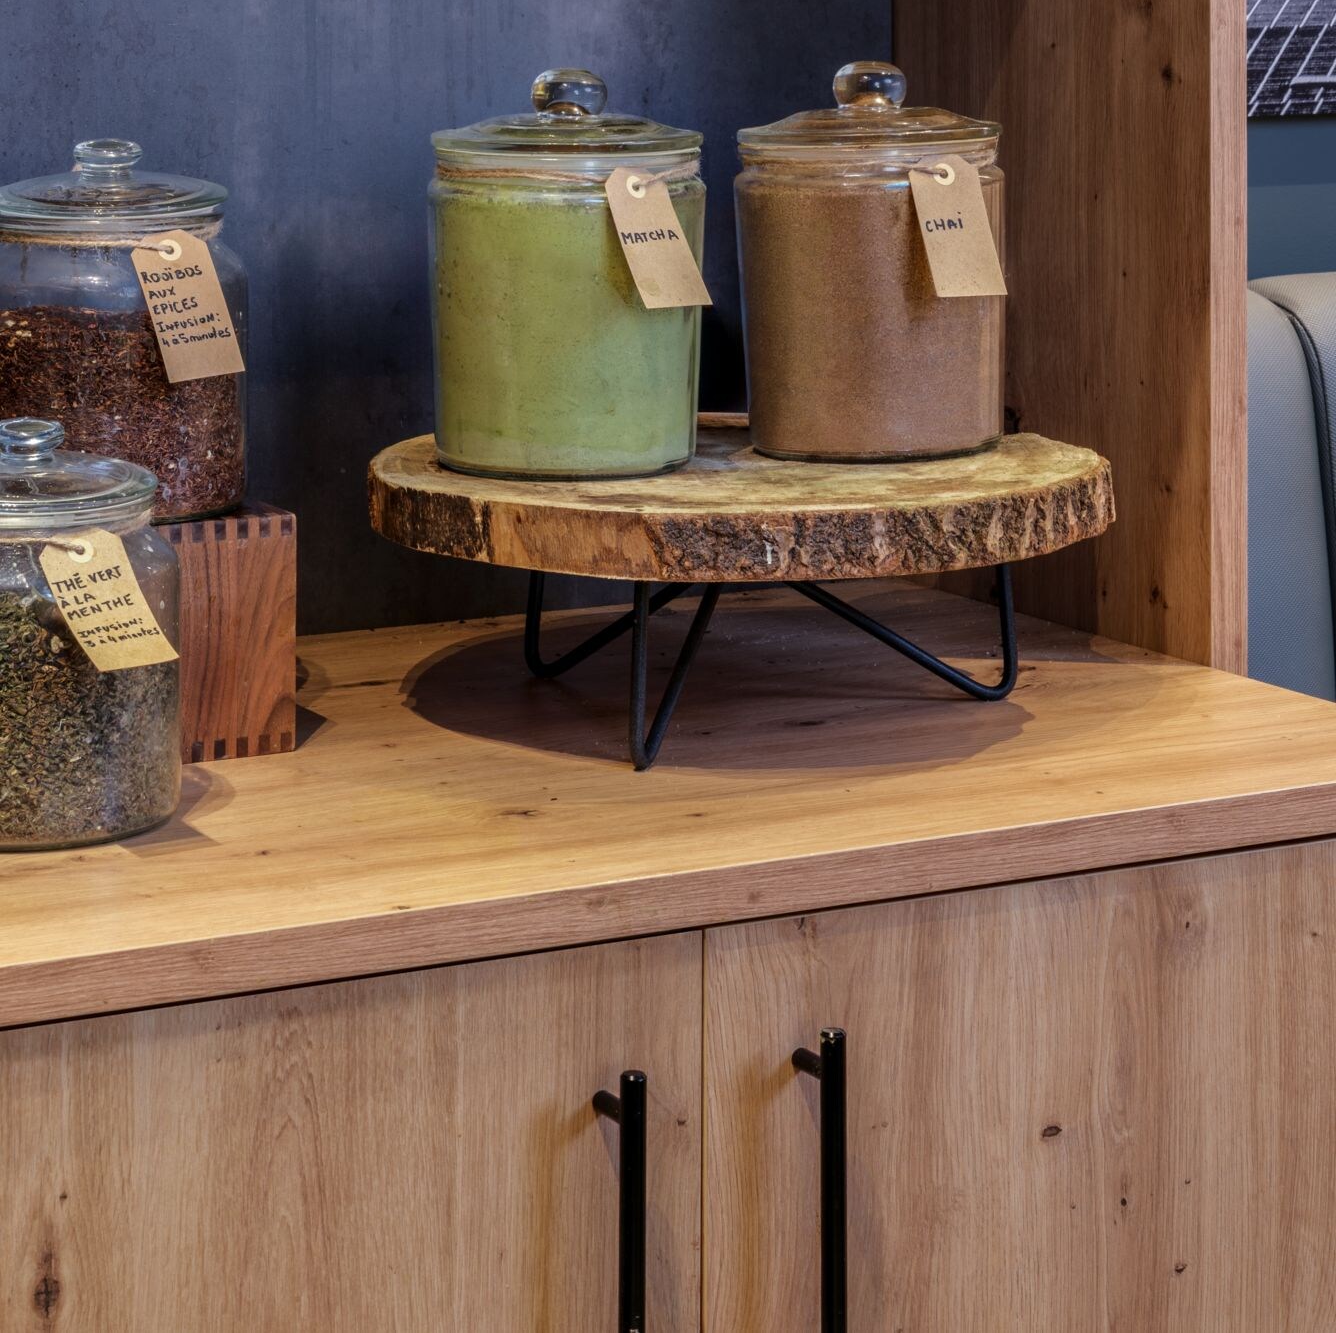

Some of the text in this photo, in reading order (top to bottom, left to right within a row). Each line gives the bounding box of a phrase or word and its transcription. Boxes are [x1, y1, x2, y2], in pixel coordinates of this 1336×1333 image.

[621, 229, 679, 245] MATCHA
[148, 286, 176, 300] AUX
[162, 337, 170, 347] 4
[51, 565, 122, 593] THÉ VERT
[57, 593, 96, 609] À LA
[67, 593, 134, 621] MENTHE
[83, 640, 96, 648] 3
[107, 635, 118, 643] 4
